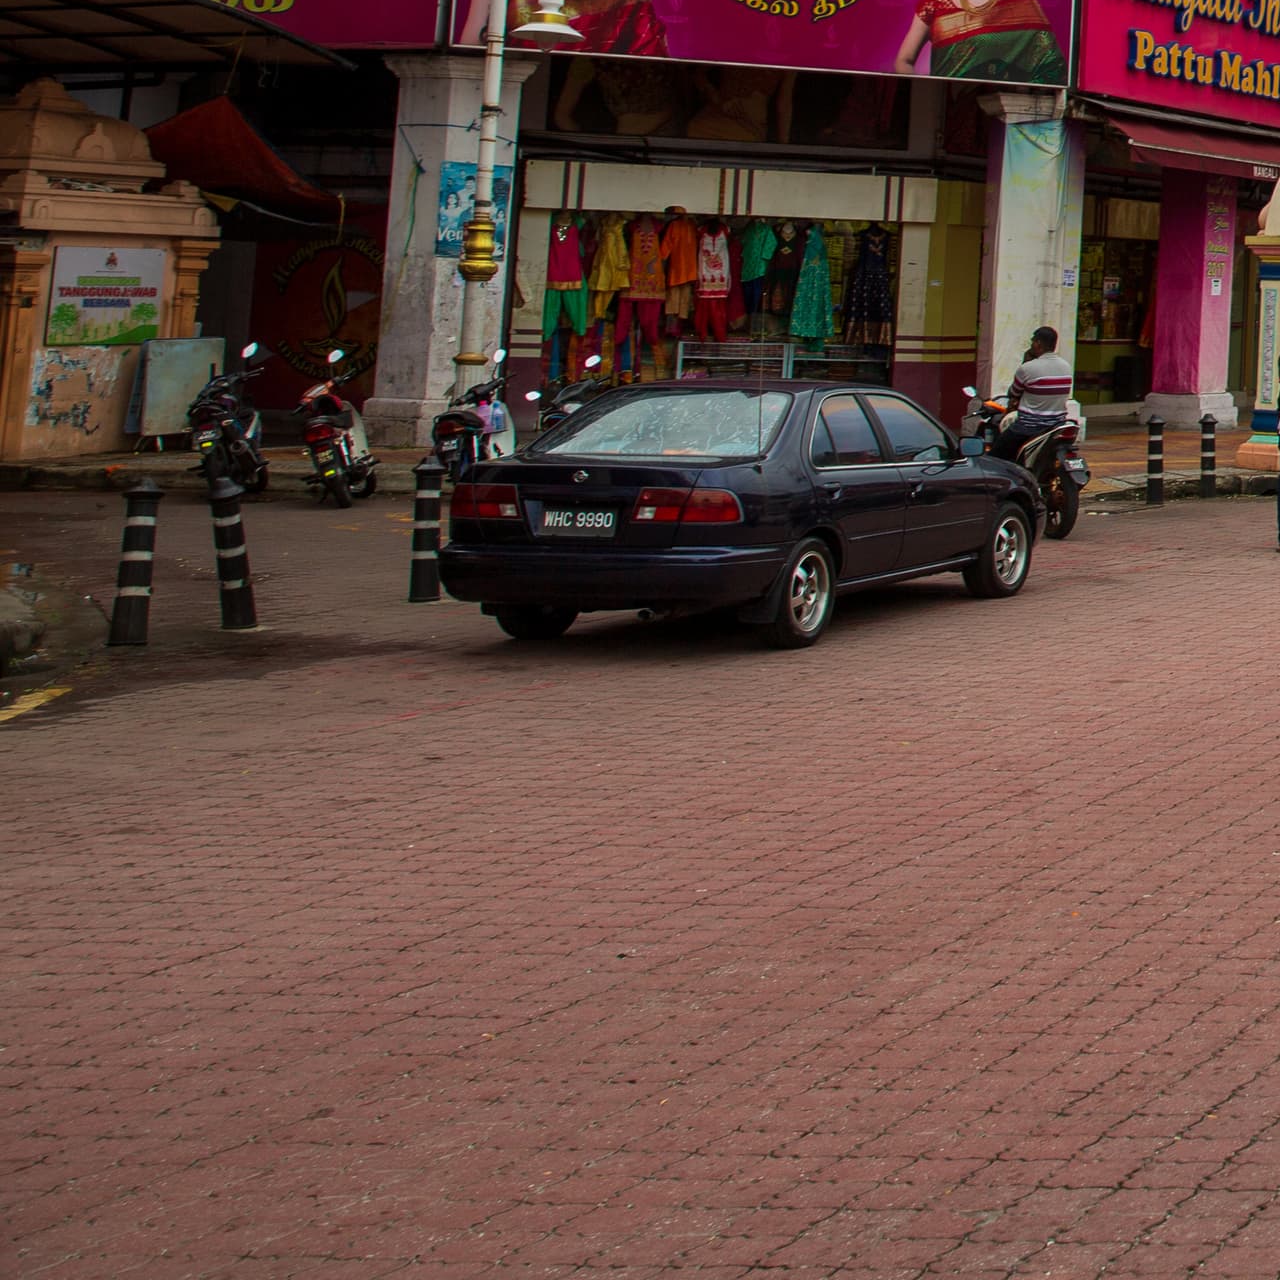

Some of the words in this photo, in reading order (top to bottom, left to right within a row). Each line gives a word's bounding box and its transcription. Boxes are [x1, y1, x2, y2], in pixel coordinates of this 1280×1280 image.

[1130, 28, 1215, 87] Pattu
[543, 510, 574, 528] WHC
[575, 511, 614, 529] 9990
